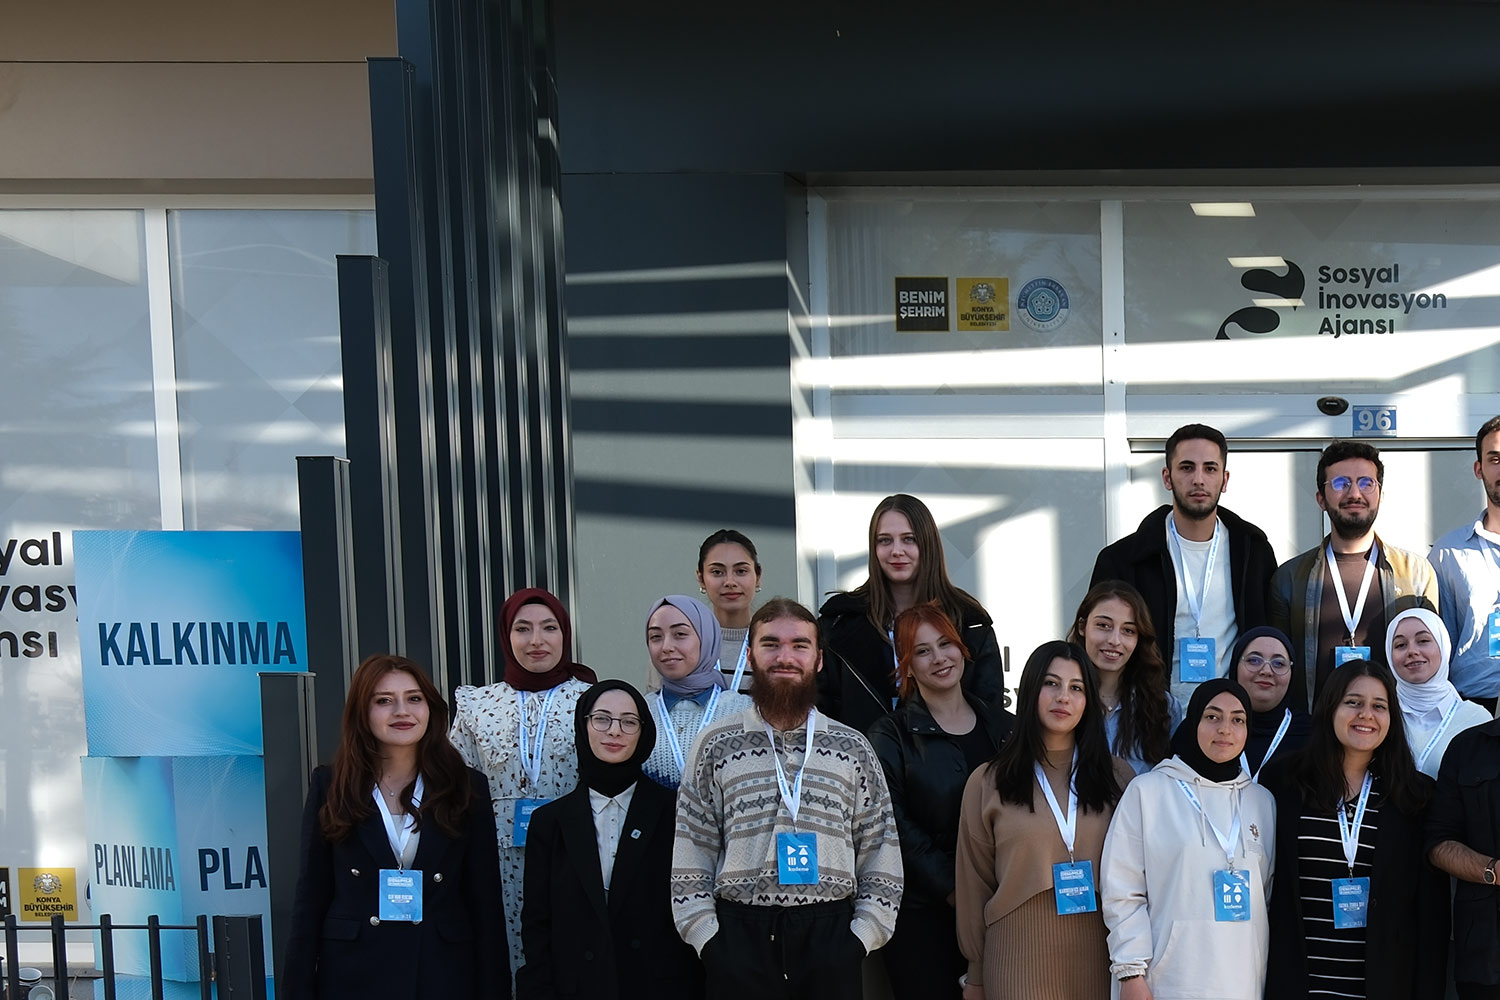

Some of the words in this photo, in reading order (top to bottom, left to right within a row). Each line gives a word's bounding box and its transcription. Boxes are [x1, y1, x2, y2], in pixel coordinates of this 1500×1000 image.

[1318, 263, 1400, 289] Sosyal
[1318, 286, 1447, 314] İnovasyon
[1317, 314, 1395, 339] Ajansı
[1358, 410, 1392, 431] 96
[98, 621, 298, 666] KALKINMA
[94, 843, 176, 892] PLANLAMA
[198, 846, 268, 892] PLA
[24, 903, 74, 912] BÜYÜKŞEHİR
